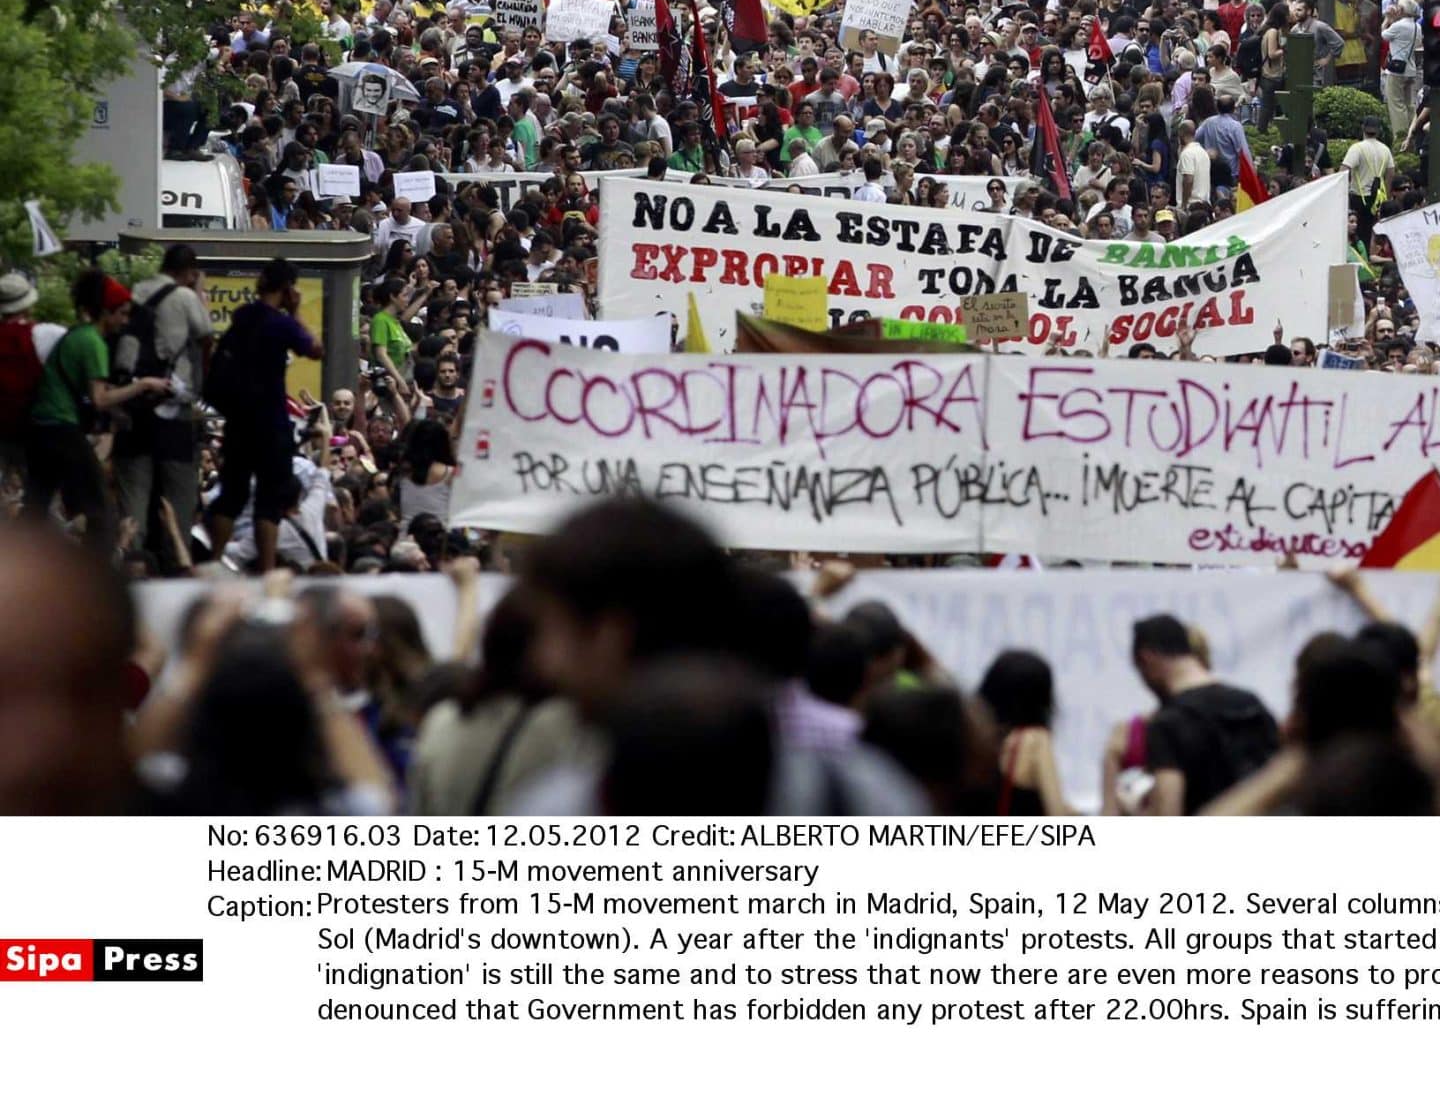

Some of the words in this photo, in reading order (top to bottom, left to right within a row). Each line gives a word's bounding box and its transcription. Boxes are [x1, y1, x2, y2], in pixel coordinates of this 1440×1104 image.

[631, 191, 697, 232] NO
[702, 199, 739, 235] A
[752, 204, 822, 241] LA
[835, 211, 1008, 262] ESTAFA
[1025, 229, 1083, 264] DE
[1096, 233, 1251, 269] BANKIA
[1038, 275, 1101, 309] LA
[1109, 289, 1256, 346] SOCIAL
[503, 343, 981, 460] COORDINADORA
[1018, 364, 1376, 470] ESTUDIANTIL
[512, 451, 579, 496] POR
[581, 457, 642, 497] UNA
[656, 460, 904, 526] ENSEÑANZA
[1224, 476, 1277, 528] AL
